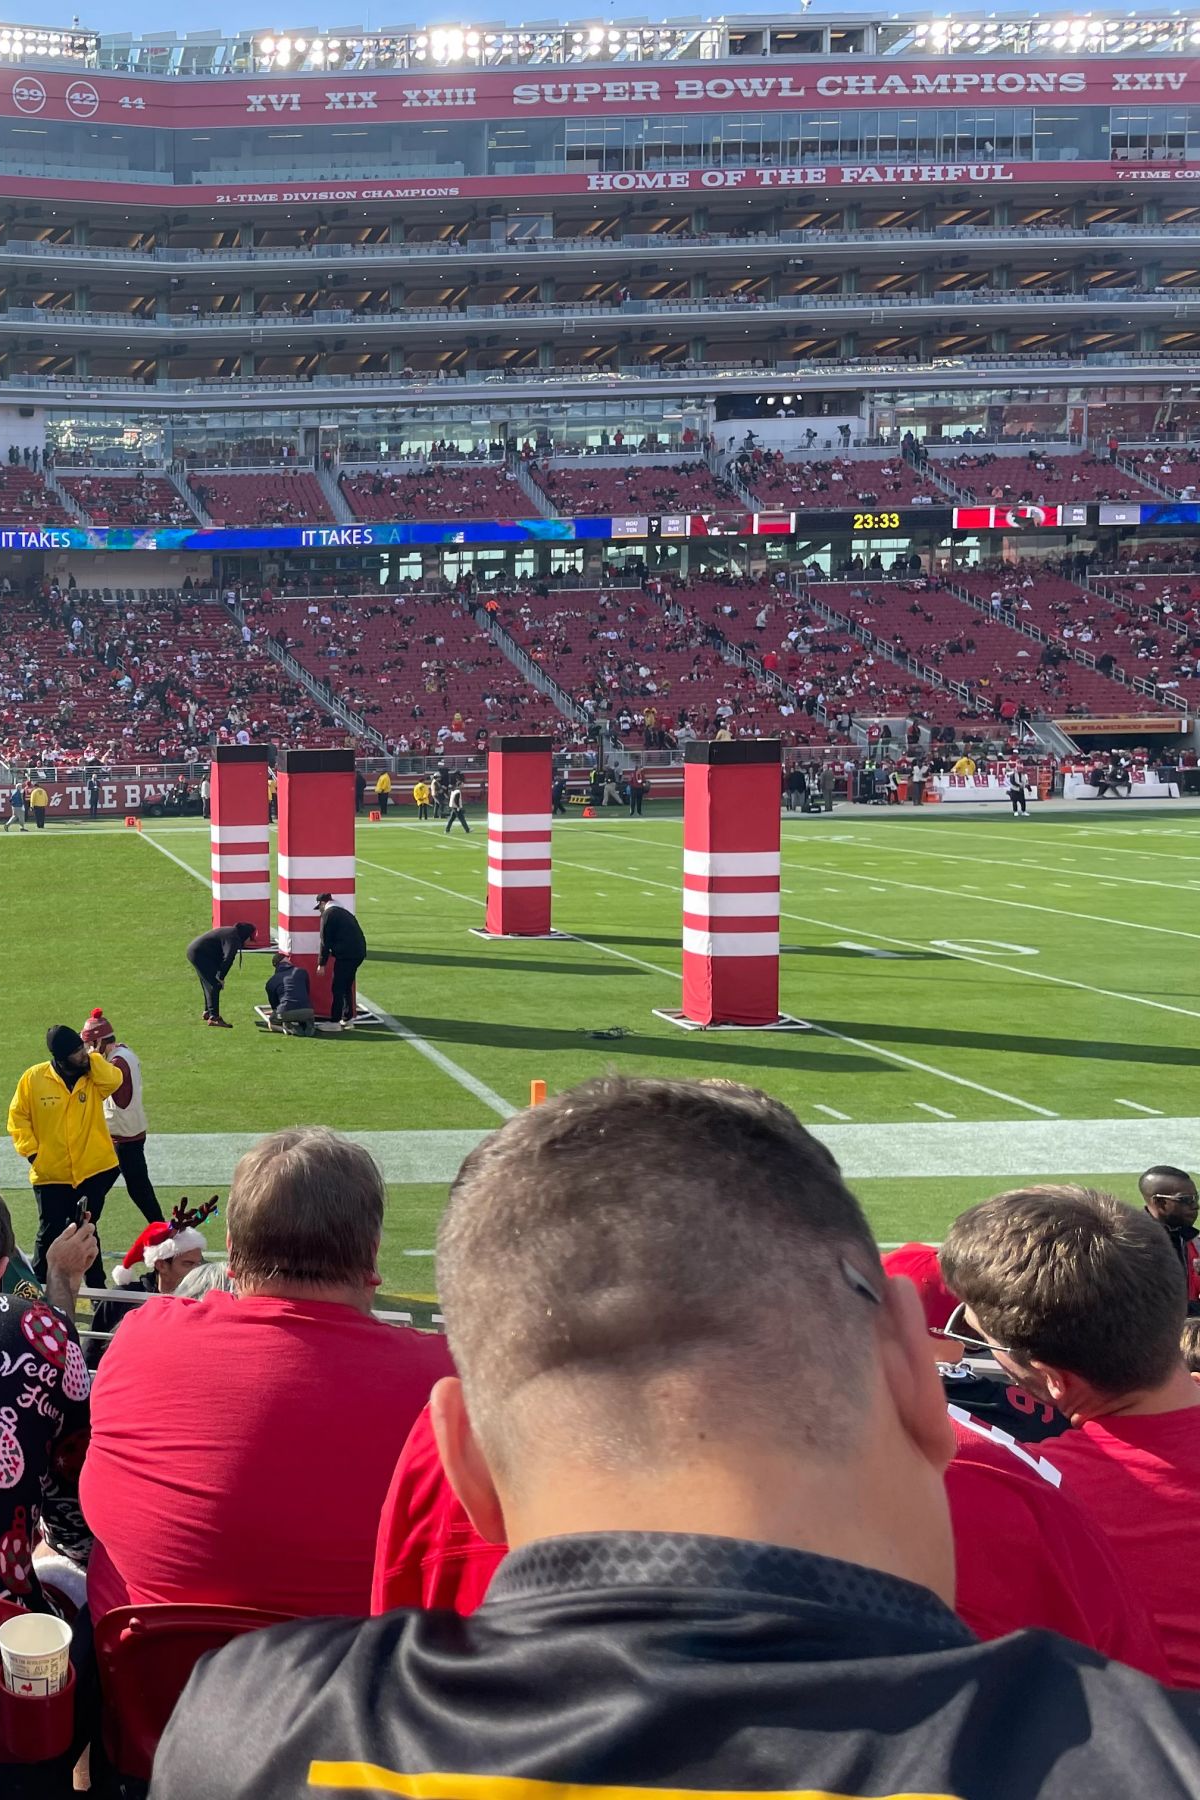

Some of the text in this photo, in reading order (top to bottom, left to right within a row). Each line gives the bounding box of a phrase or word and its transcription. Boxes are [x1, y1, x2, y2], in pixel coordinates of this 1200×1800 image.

[513, 71, 1088, 105] SUPER BOWL CHAMPIONS
[1112, 72, 1188, 91] XXIV
[16, 87, 43, 102] 39
[70, 92, 96, 106] 42
[118, 96, 146, 110] 44
[246, 93, 301, 113] XVI
[325, 91, 378, 110] XIX
[402, 88, 477, 108] XXIII
[586, 163, 1014, 191] HOME OF THE FAITHFUL
[1116, 171, 1171, 179] 7-TIME
[216, 186, 460, 203] 21-TIME DIVISION CHAMPIONS
[853, 512, 900, 530] 23:33
[17, 532, 71, 548] TAKES
[318, 528, 373, 545] TAKES
[49, 792, 63, 807] to
